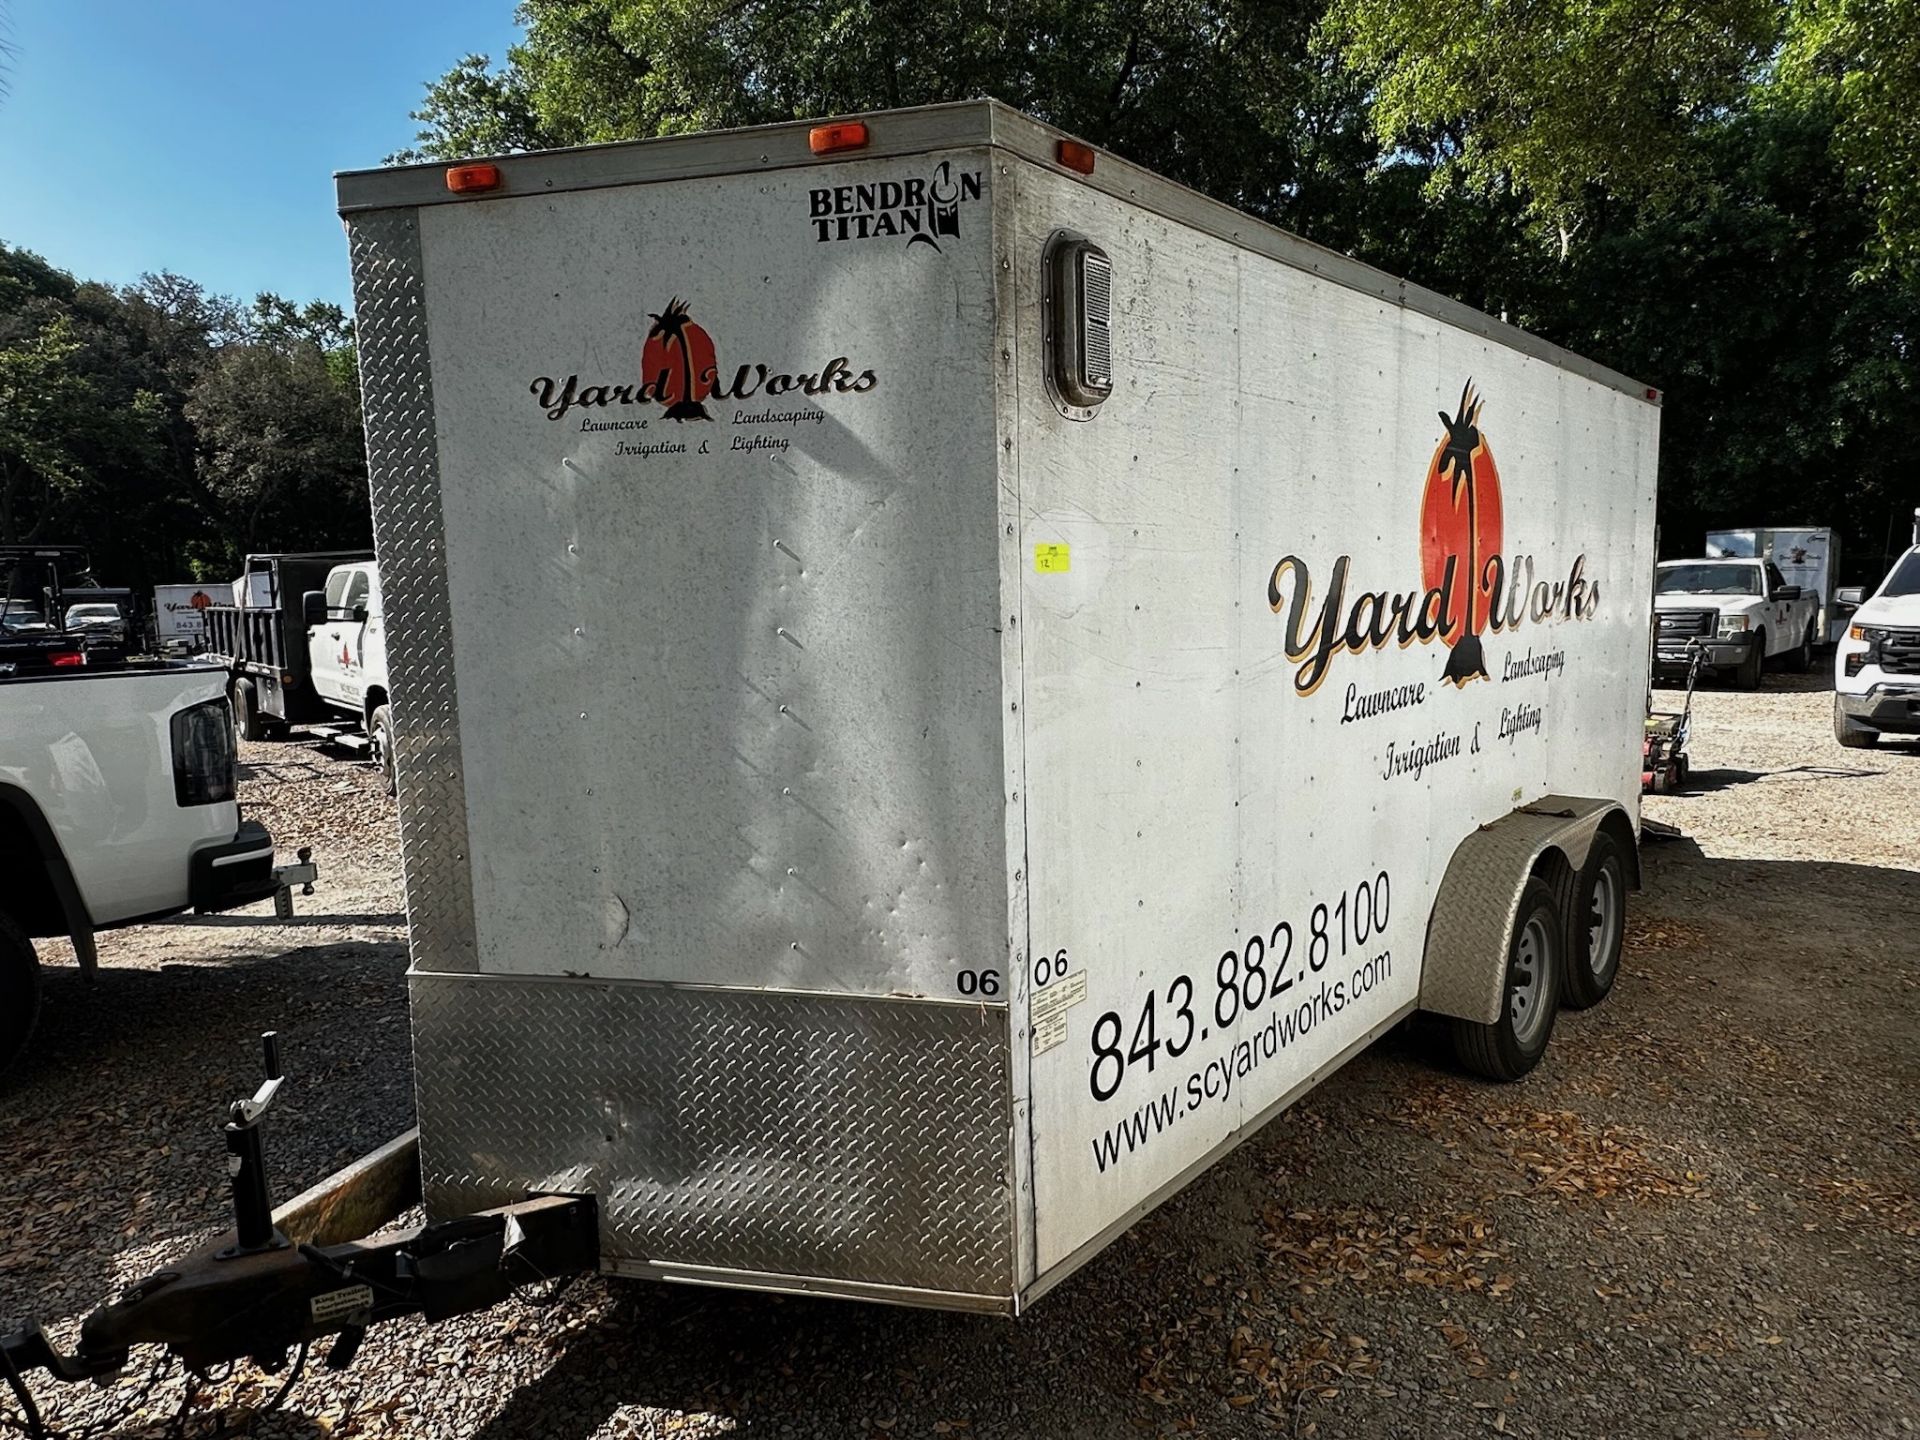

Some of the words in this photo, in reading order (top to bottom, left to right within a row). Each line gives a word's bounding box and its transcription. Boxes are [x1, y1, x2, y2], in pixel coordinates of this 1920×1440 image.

[808, 162, 982, 219] BENDRON
[811, 208, 923, 243] TITAN
[529, 368, 671, 422] Yard
[701, 356, 879, 401] Works
[580, 417, 648, 432] Lawncare
[731, 407, 826, 426] Landscaping
[614, 440, 686, 459] Irrigation
[698, 440, 710, 455] &
[730, 435, 790, 454] Lighting
[1268, 554, 1458, 697] Yard
[1482, 553, 1601, 634] Works
[1340, 682, 1425, 725] Lawncare
[1502, 646, 1565, 683] Landscaping
[1383, 732, 1461, 782] Irrigation
[1470, 721, 1481, 755] &
[1498, 704, 1542, 746] Lighting
[956, 969, 1000, 996] 06
[1033, 948, 1069, 987] 06
[1089, 870, 1390, 1102] 843.882.8100
[1092, 950, 1392, 1174] www.scyardworks.com
